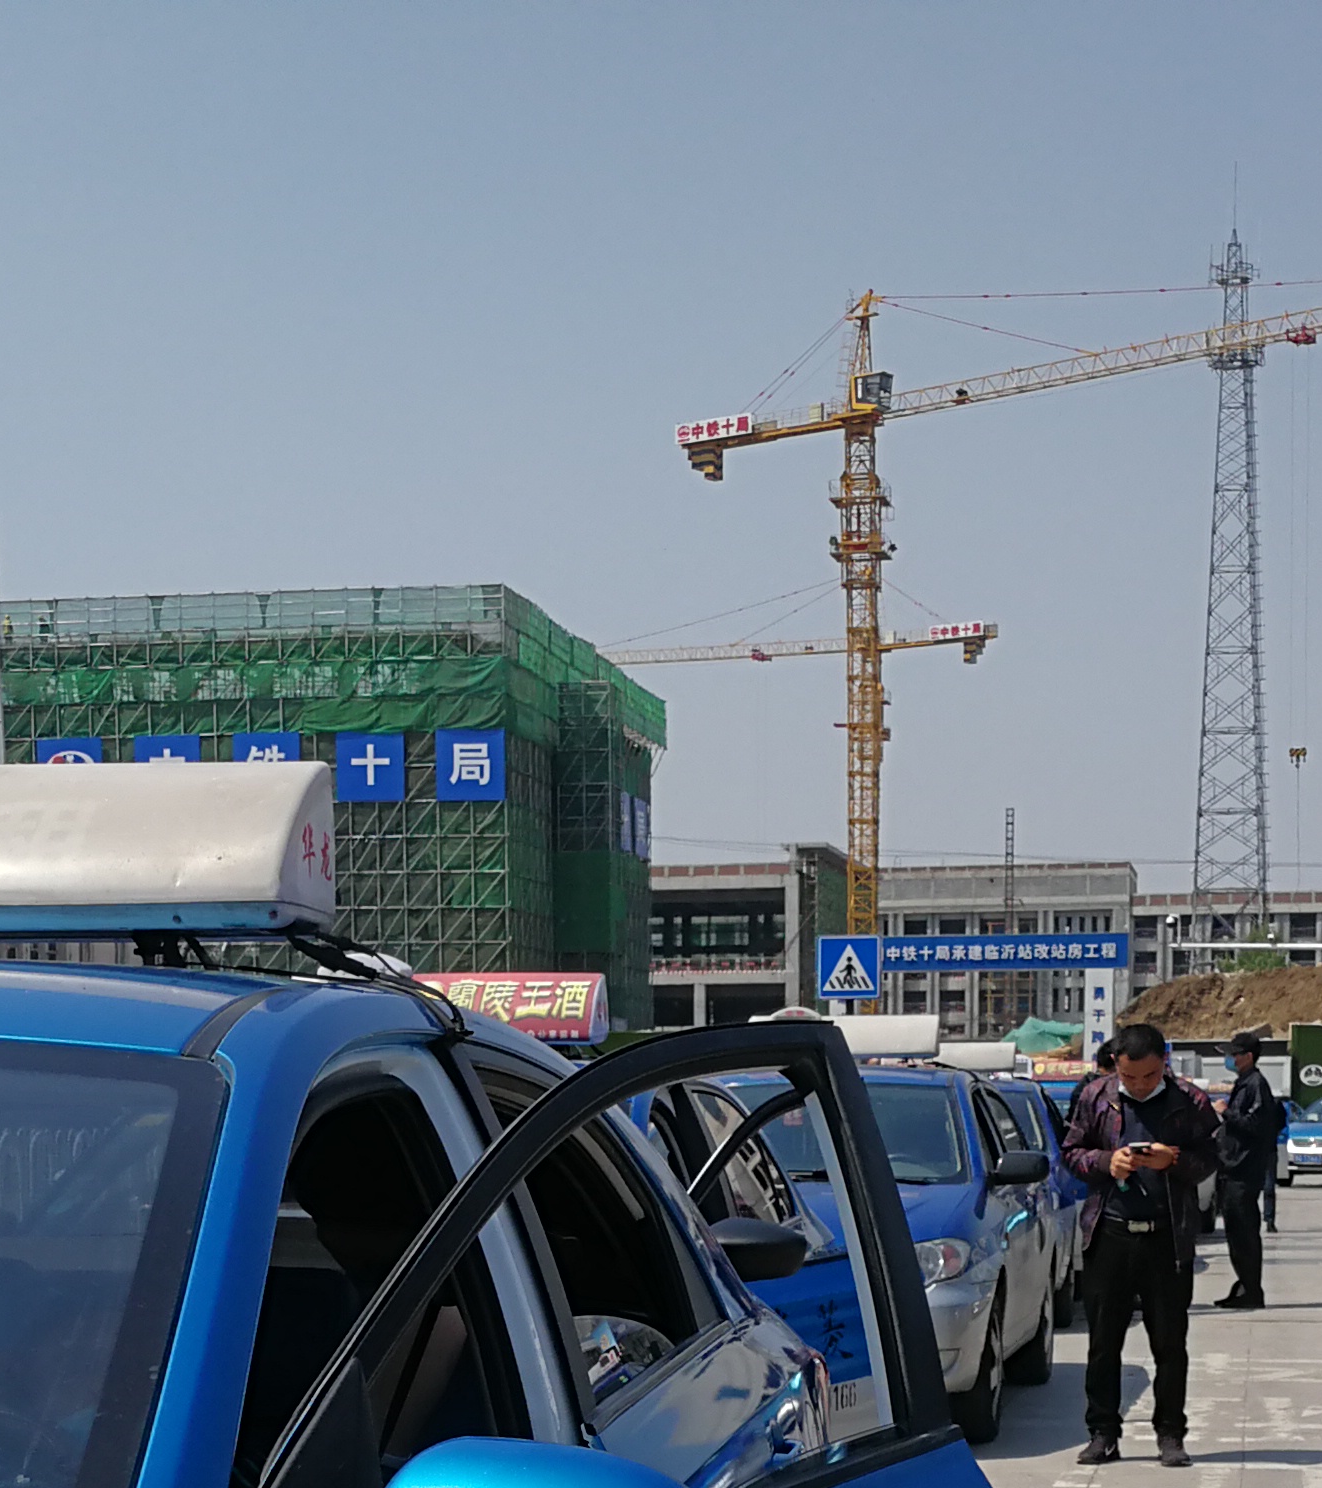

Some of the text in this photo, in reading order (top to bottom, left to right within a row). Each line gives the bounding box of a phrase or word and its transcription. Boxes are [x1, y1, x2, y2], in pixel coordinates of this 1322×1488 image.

[691, 415, 750, 441] 中铁十局
[885, 942, 1117, 963] 中铁十局承建临沂站改站房工程
